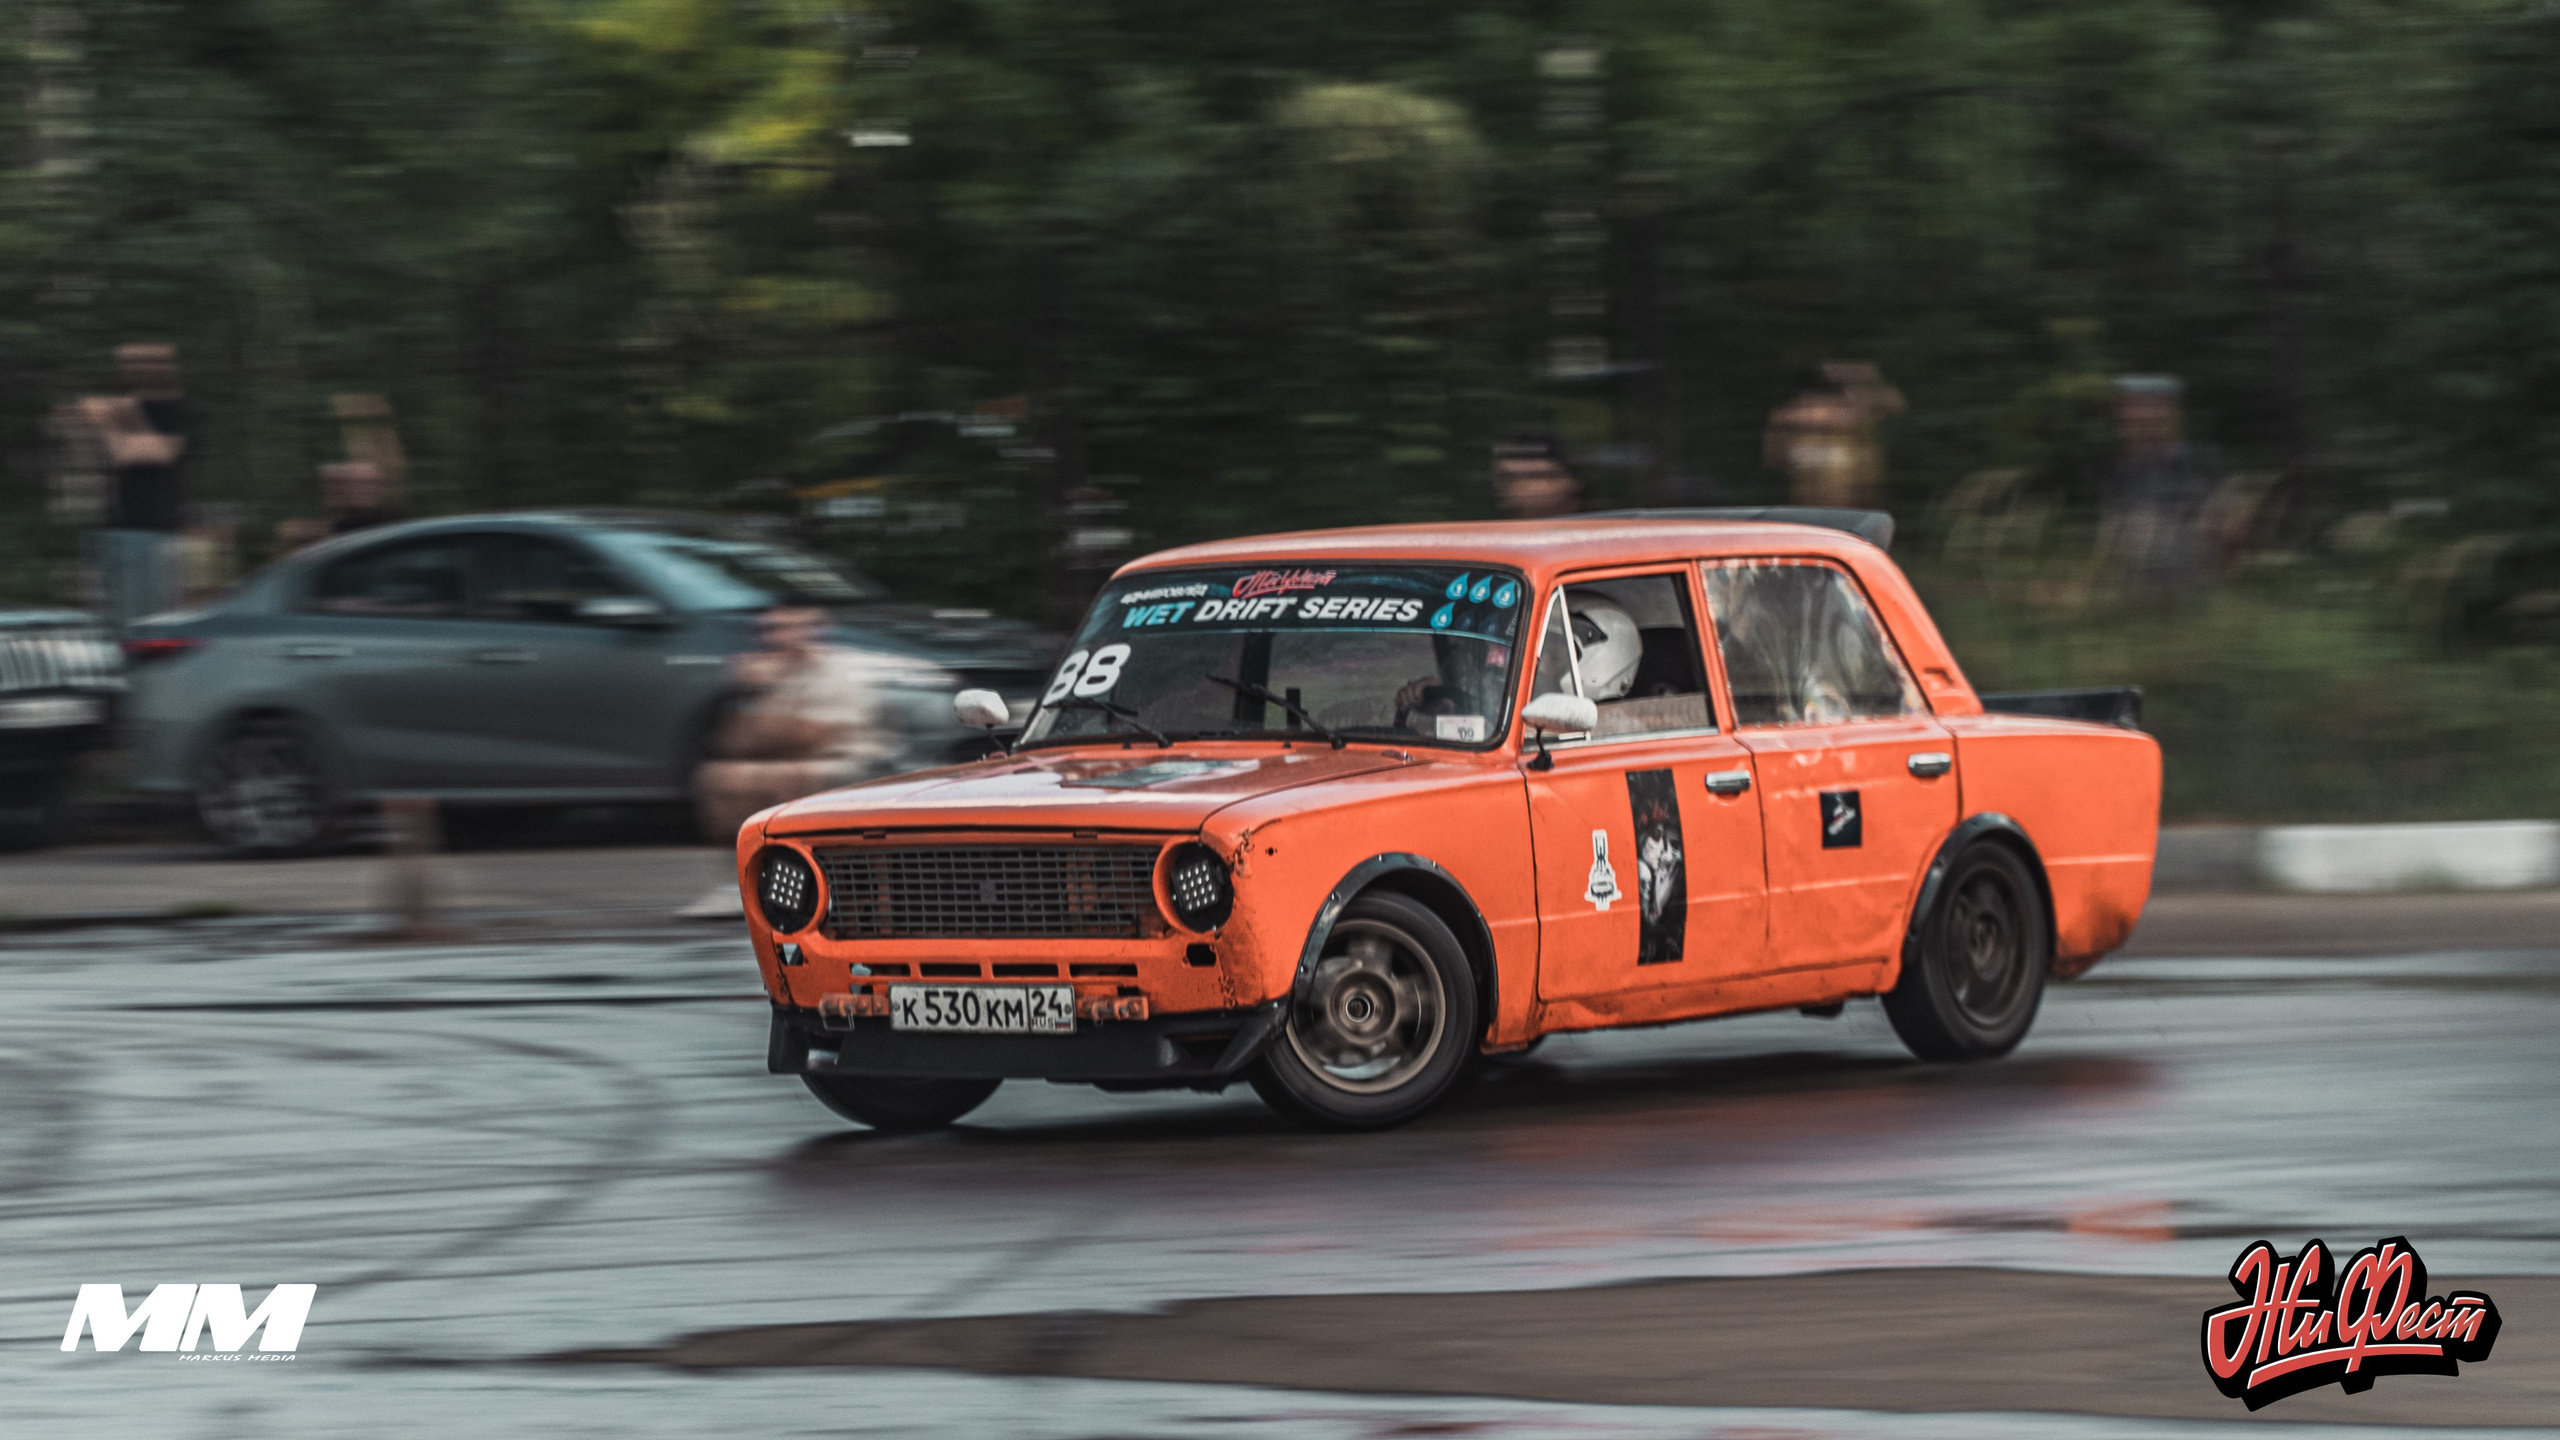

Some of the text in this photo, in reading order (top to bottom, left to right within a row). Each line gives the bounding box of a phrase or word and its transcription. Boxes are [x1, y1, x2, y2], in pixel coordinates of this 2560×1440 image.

[1123, 597, 1424, 628] WET DRIFT SERIES
[1041, 643, 1132, 706] 88
[1031, 990, 1063, 1018] 24
[1031, 1017, 1055, 1029] RUS
